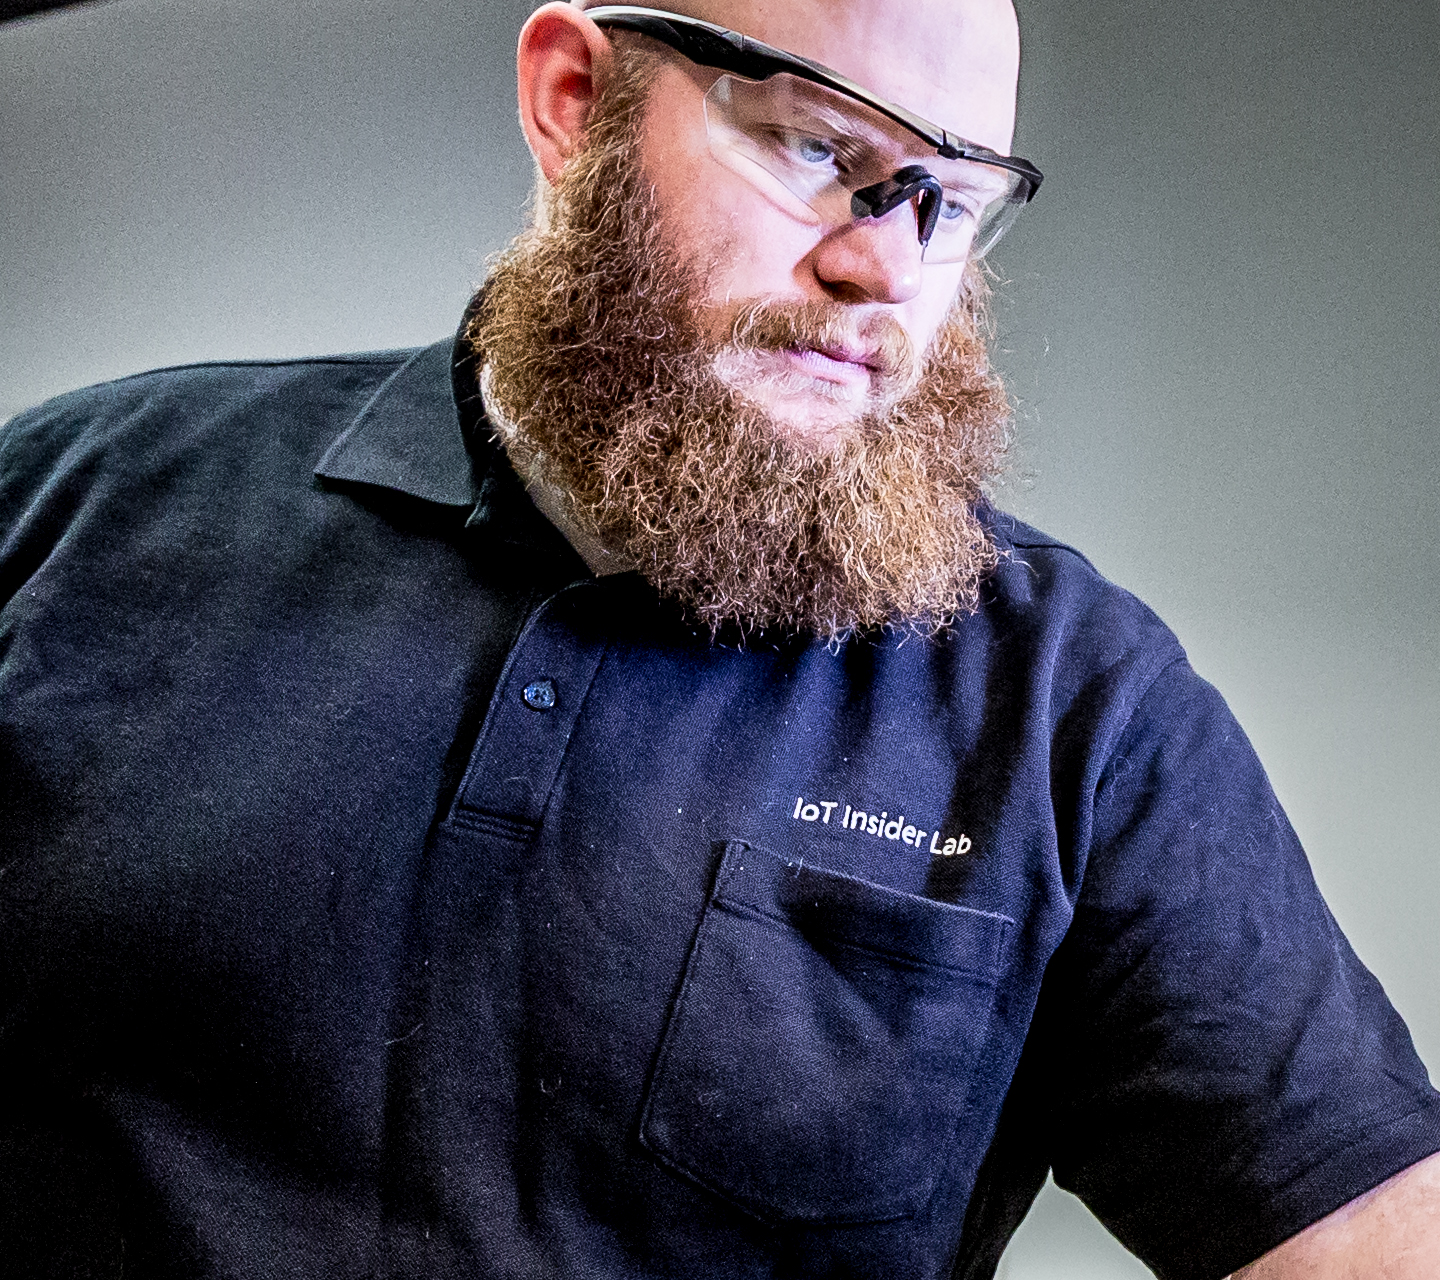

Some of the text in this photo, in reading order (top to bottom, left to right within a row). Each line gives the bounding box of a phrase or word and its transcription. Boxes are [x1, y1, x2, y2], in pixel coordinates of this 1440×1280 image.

[793, 797, 972, 856] IoT Insider Lab
